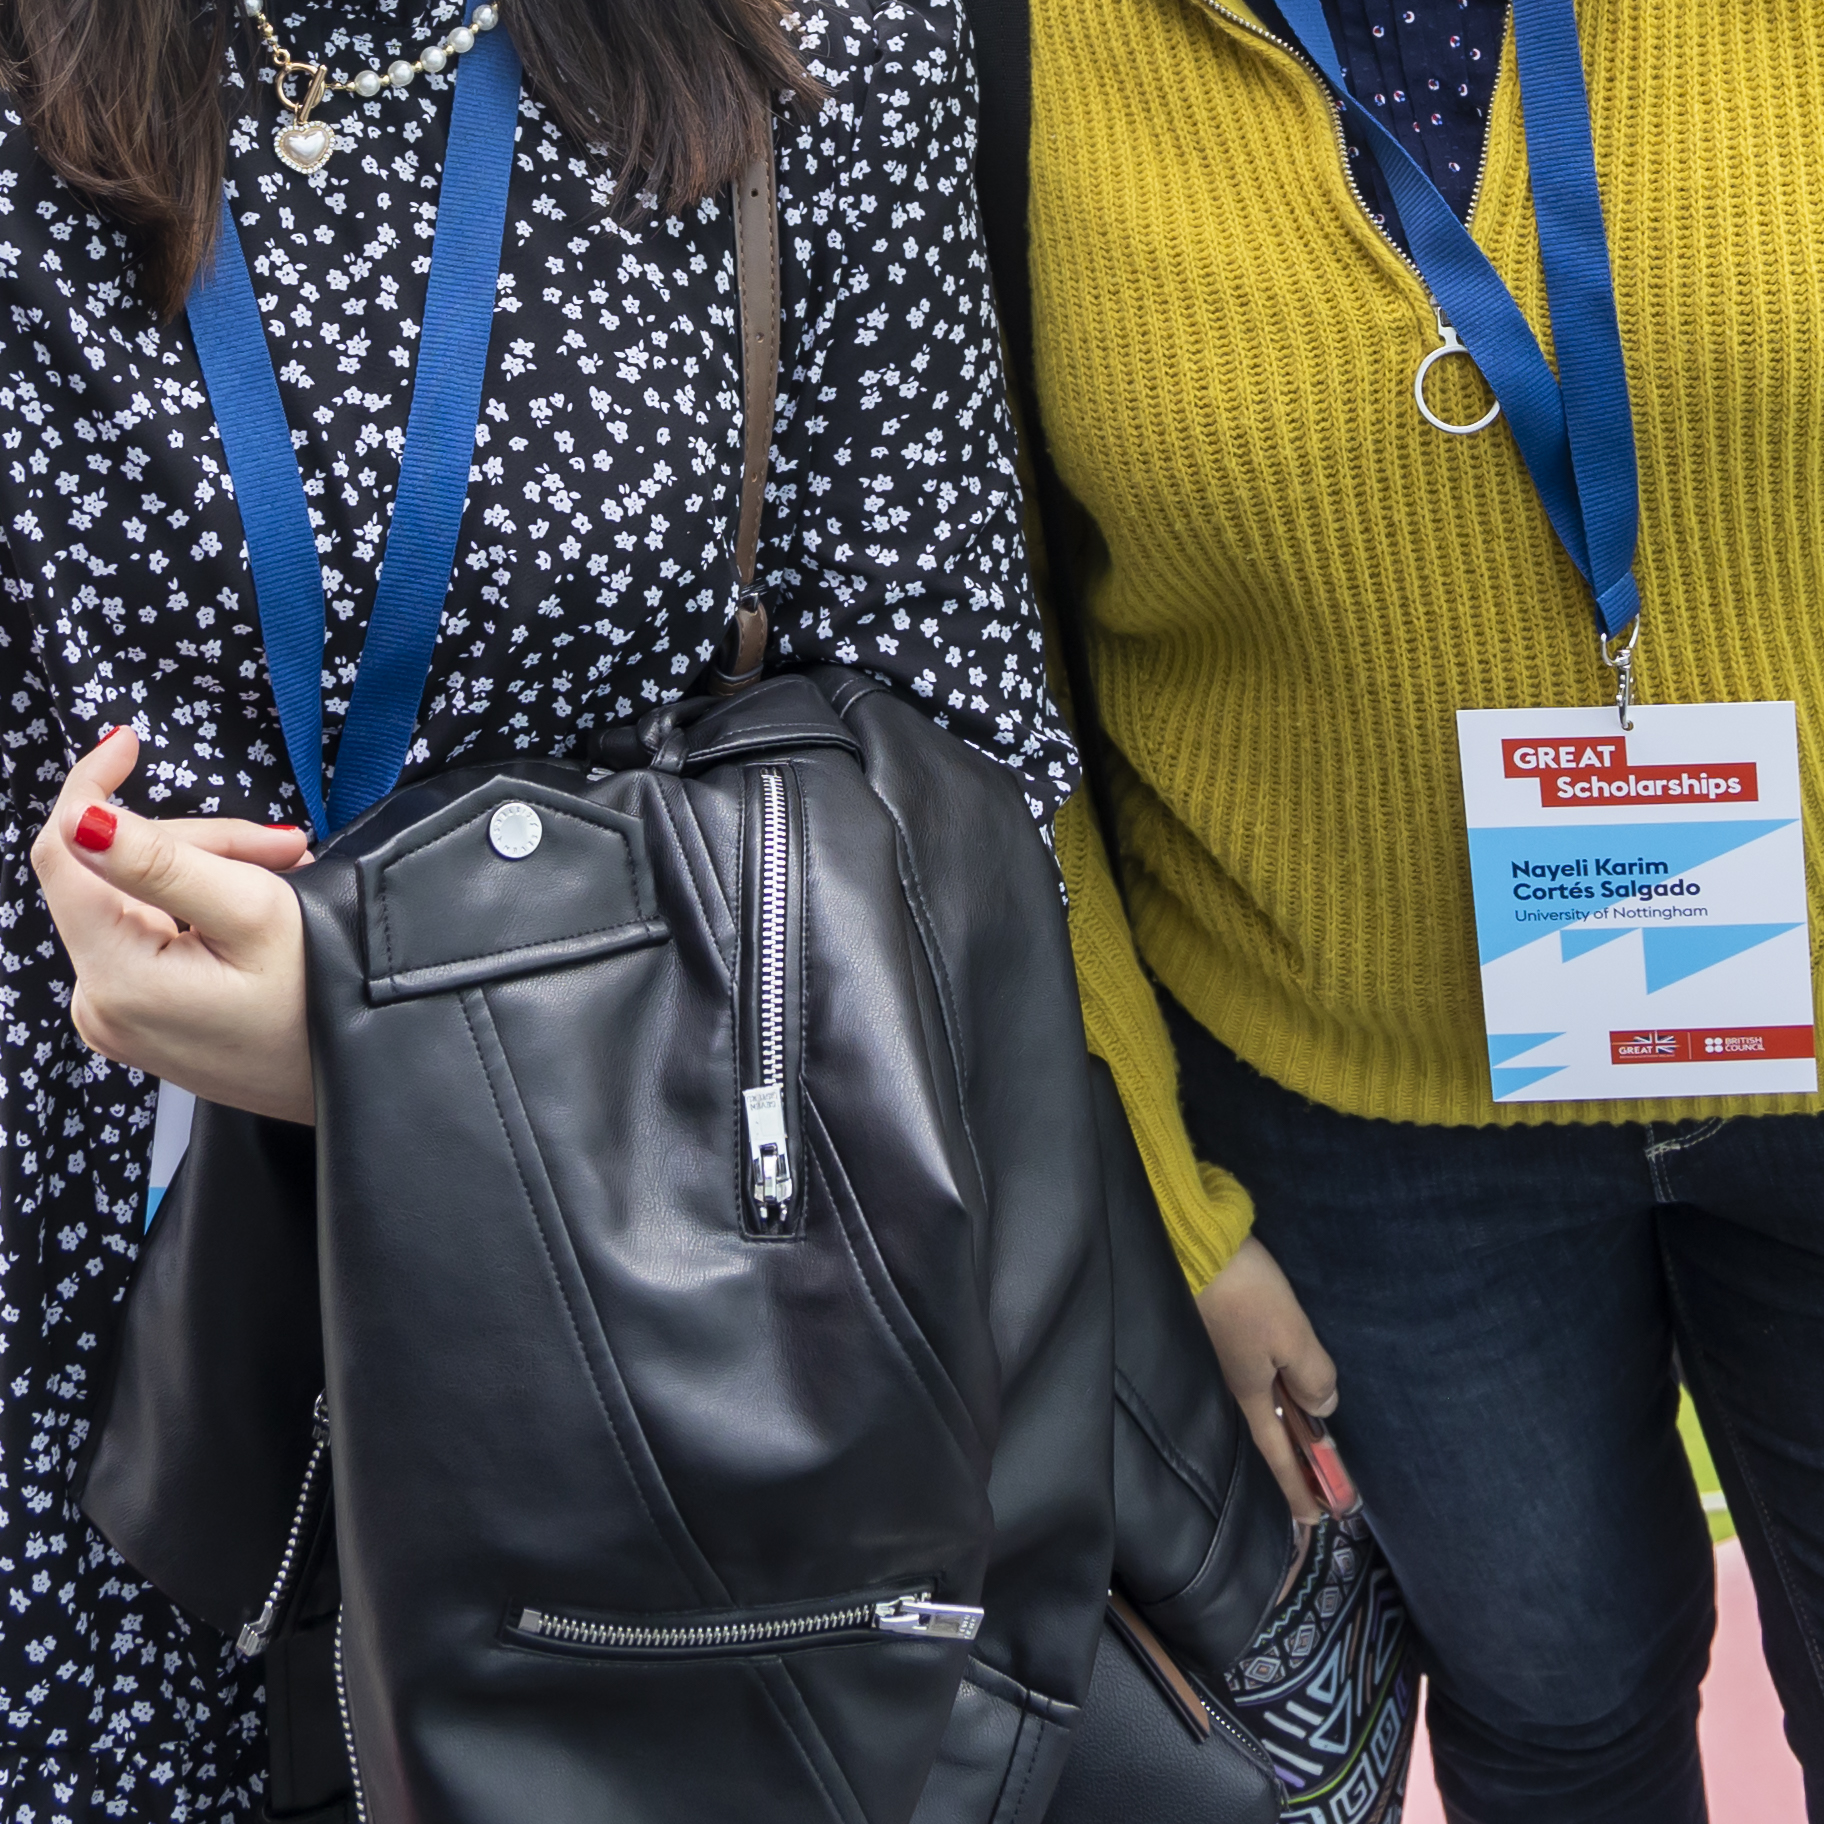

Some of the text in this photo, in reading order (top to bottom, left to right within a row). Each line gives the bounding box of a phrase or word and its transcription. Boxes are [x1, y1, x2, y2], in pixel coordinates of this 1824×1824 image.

[1513, 746, 1616, 769] GREAT
[1556, 773, 1742, 800] Scholarships
[1511, 857, 1669, 881] Nayeli Karim
[1512, 879, 1701, 901] Cortés Salgado
[1514, 905, 1708, 923] University of Nottingham
[1618, 1045, 1653, 1055] GREAT
[1724, 1037, 1763, 1045] BRITISH
[1724, 1044, 1766, 1052] COUNCIL
